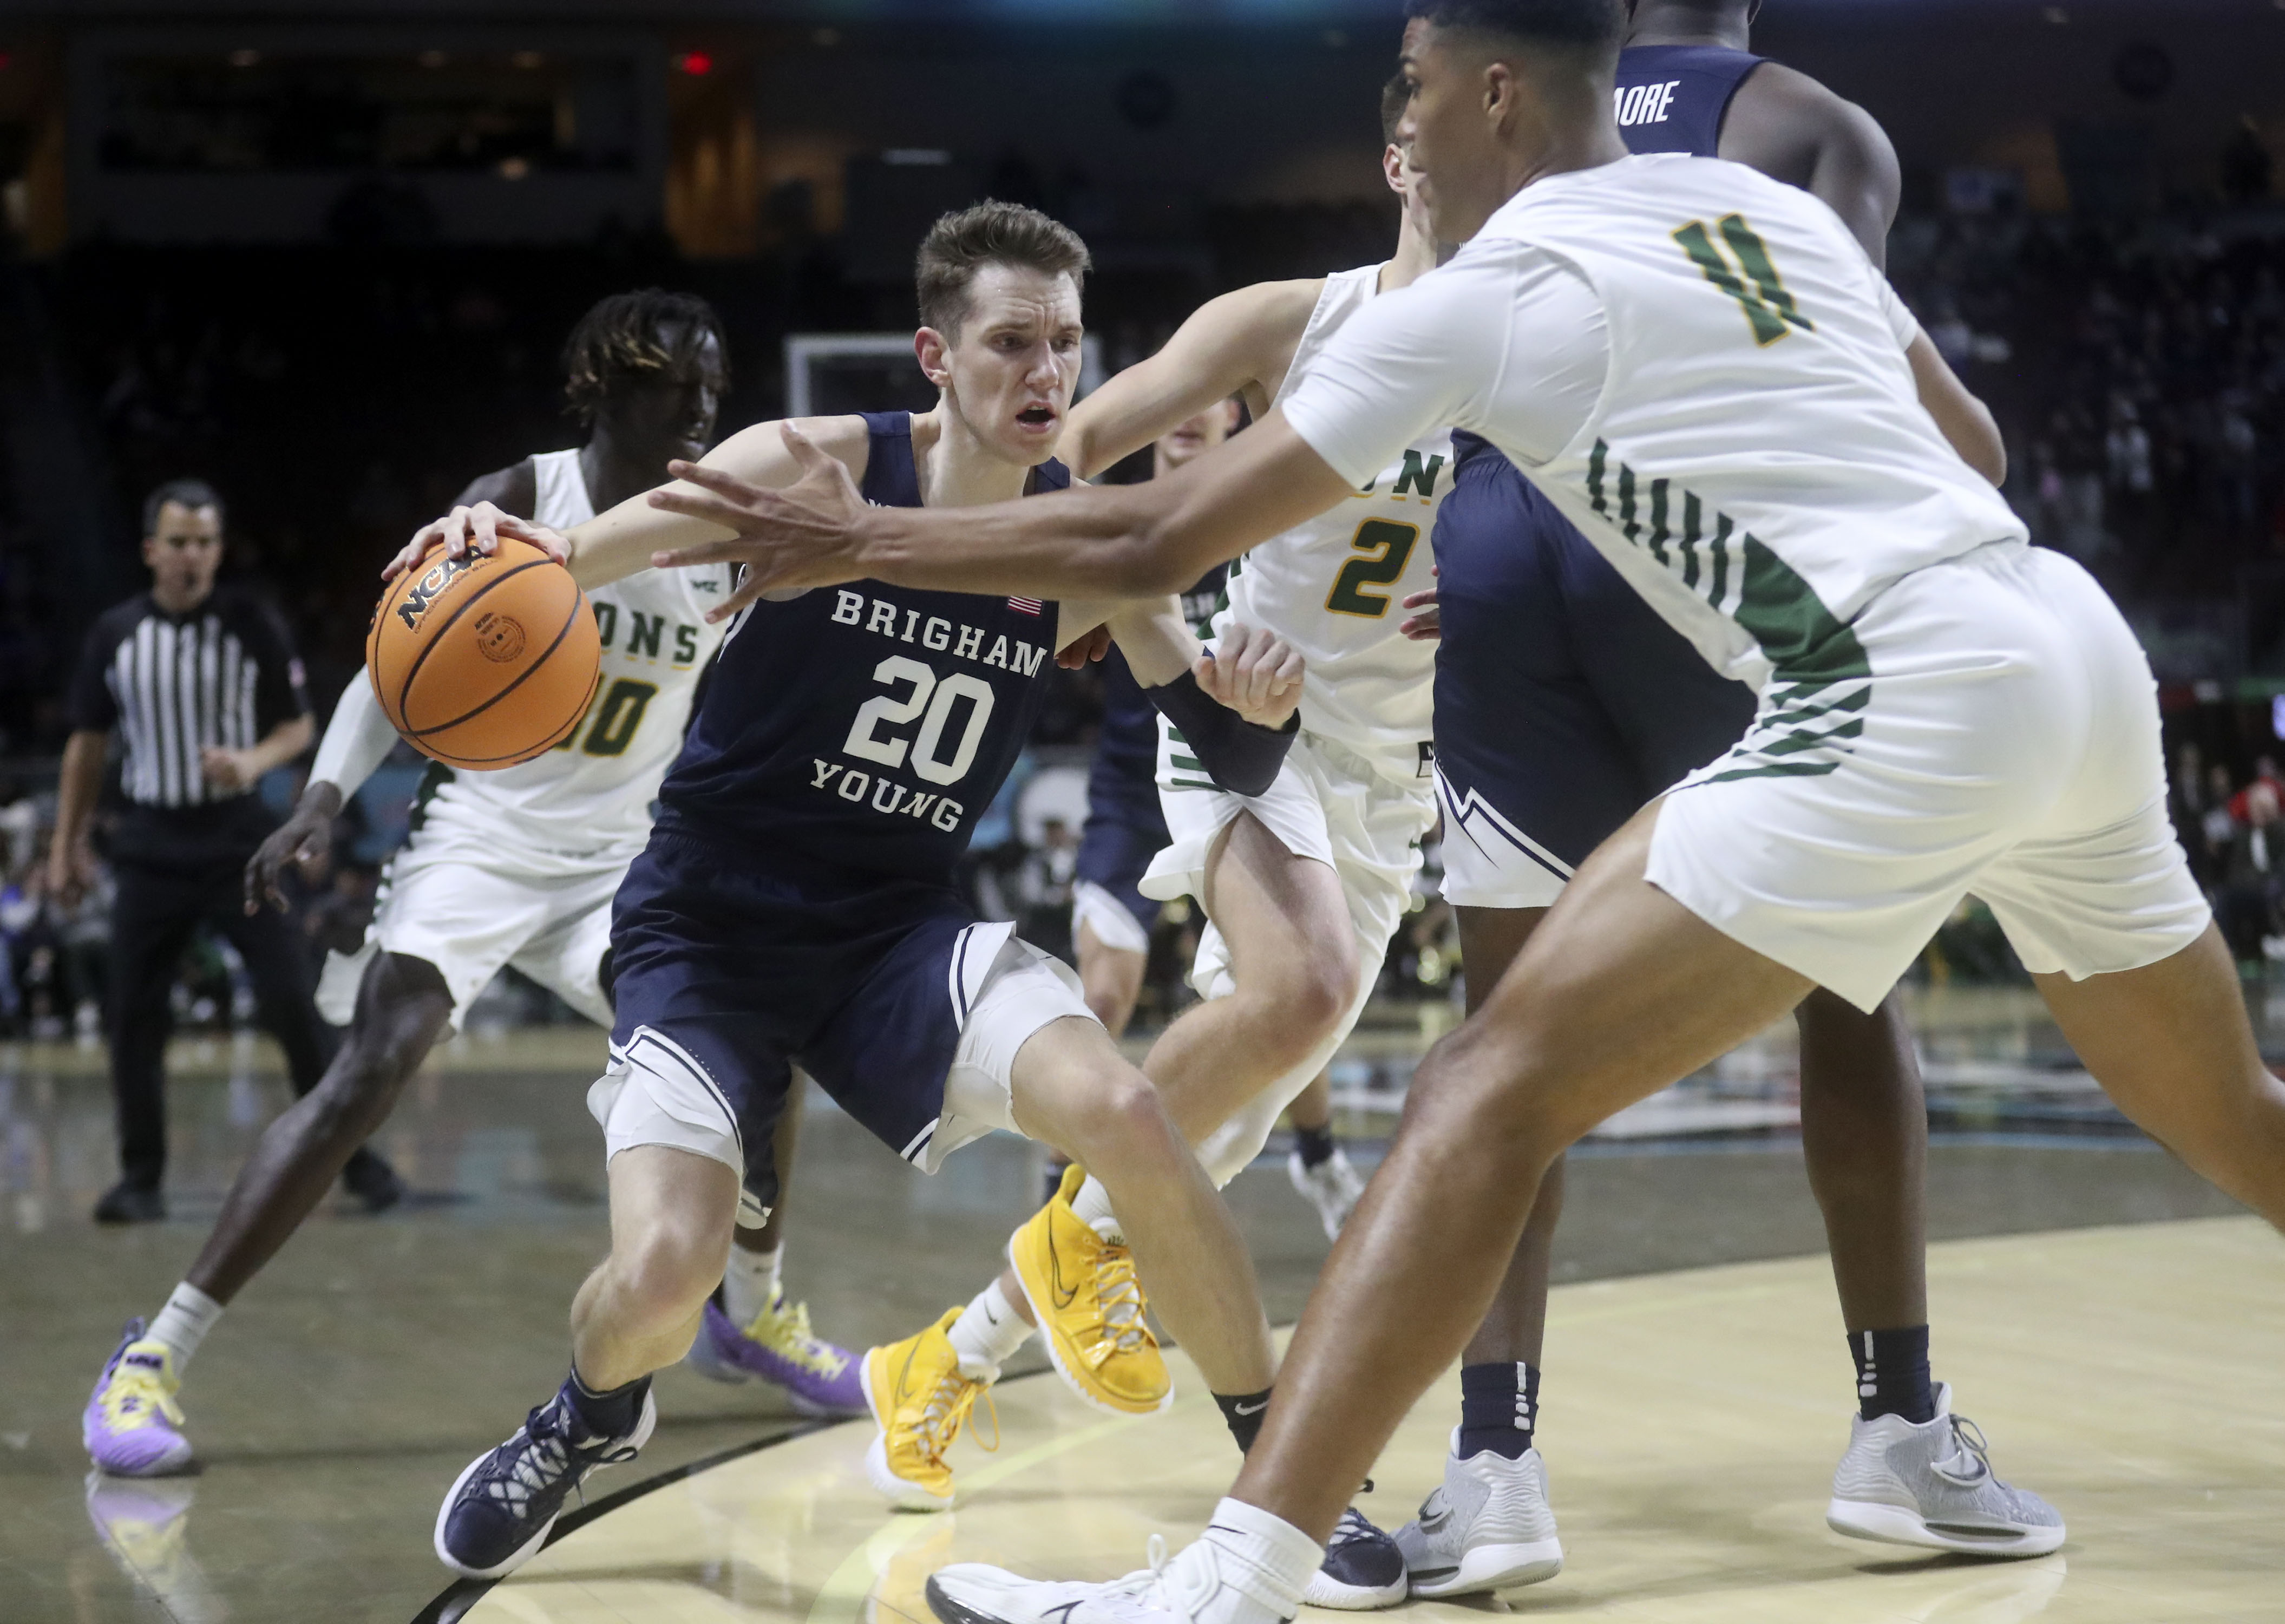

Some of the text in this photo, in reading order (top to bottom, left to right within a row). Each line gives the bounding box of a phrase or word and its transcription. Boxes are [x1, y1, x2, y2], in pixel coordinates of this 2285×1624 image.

[1669, 213, 1817, 348] 11
[396, 544, 493, 632] NCAA
[472, 559, 497, 572] BALL
[1324, 516, 1420, 619] 2
[831, 590, 1047, 678] BRIGHAM
[842, 655, 995, 786] 20
[810, 758, 964, 833] YOUNG
